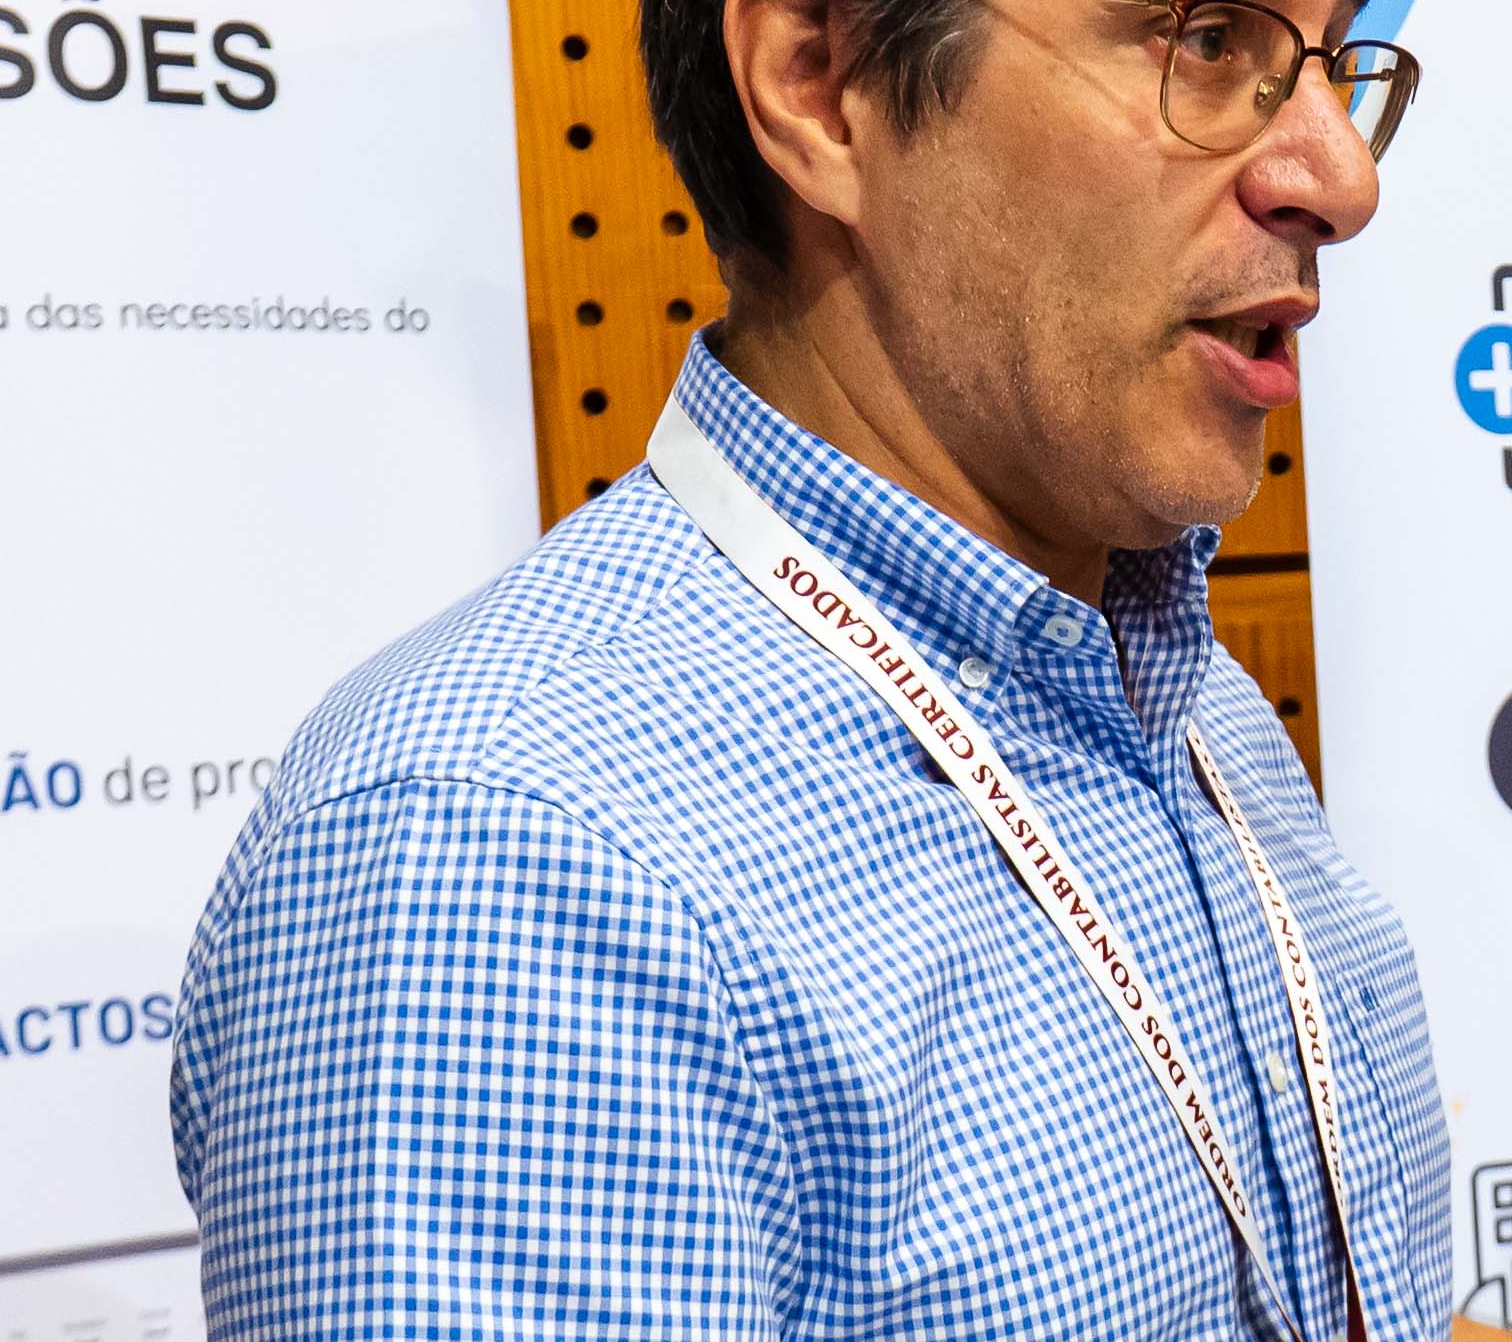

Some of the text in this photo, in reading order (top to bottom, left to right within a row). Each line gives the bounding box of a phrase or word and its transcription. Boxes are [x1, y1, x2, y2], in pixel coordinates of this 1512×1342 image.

[25, 294, 103, 334] das
[119, 295, 371, 335] necessidades
[384, 295, 431, 336] do
[102, 755, 171, 807] de
[773, 556, 1248, 1219] ORDEM DOS CONTABILISTAS CERTIFICADOS
[1298, 996, 1326, 1068] DOS
